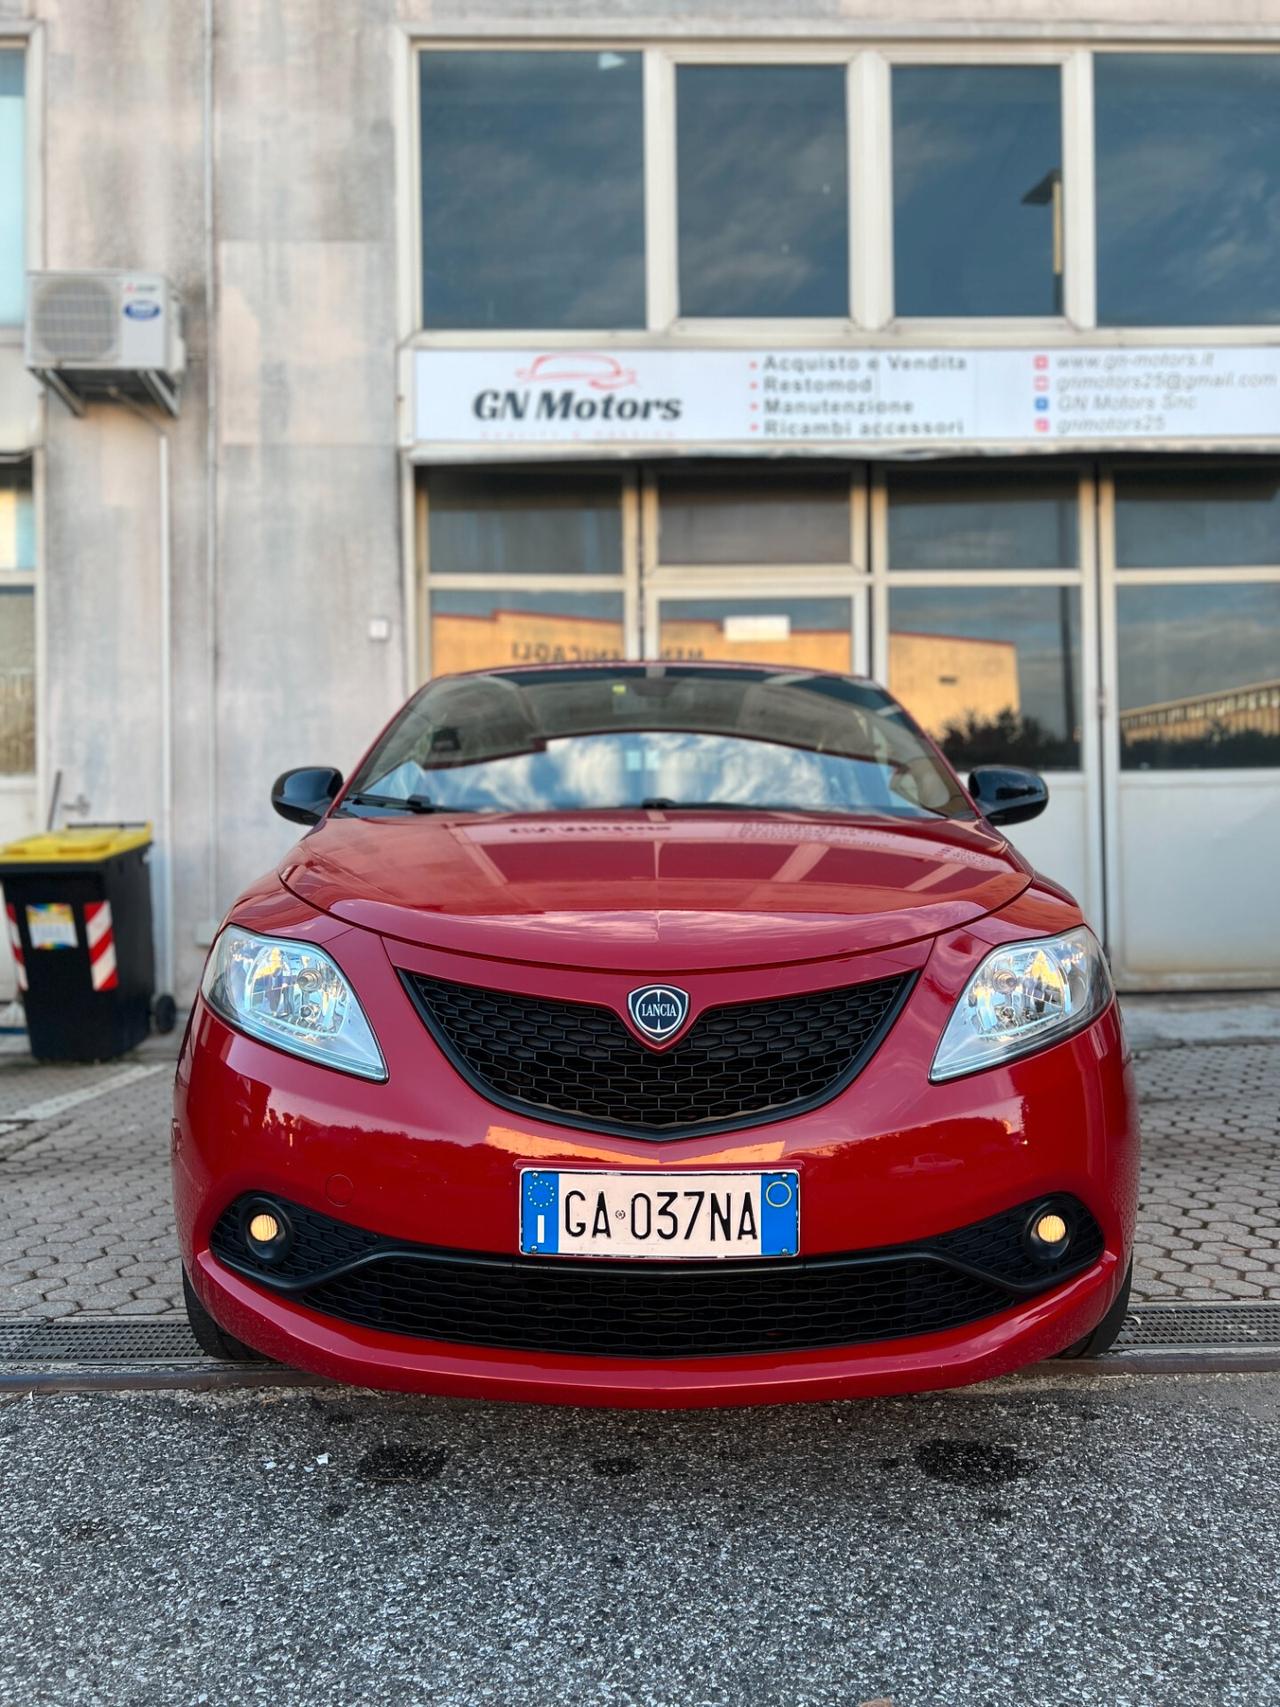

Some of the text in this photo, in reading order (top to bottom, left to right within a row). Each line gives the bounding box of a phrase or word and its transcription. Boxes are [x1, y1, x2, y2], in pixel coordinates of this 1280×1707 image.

[763, 355, 967, 373] Acquisto e Vendita
[763, 376, 873, 393] Restomod
[472, 389, 684, 421] GN Motors
[763, 399, 914, 414] Manutenzione
[1057, 396, 1087, 412] GN
[1093, 395, 1156, 411] Motors
[763, 420, 965, 436] Ricambi accessori
[641, 1003, 677, 1017] LANCIA
